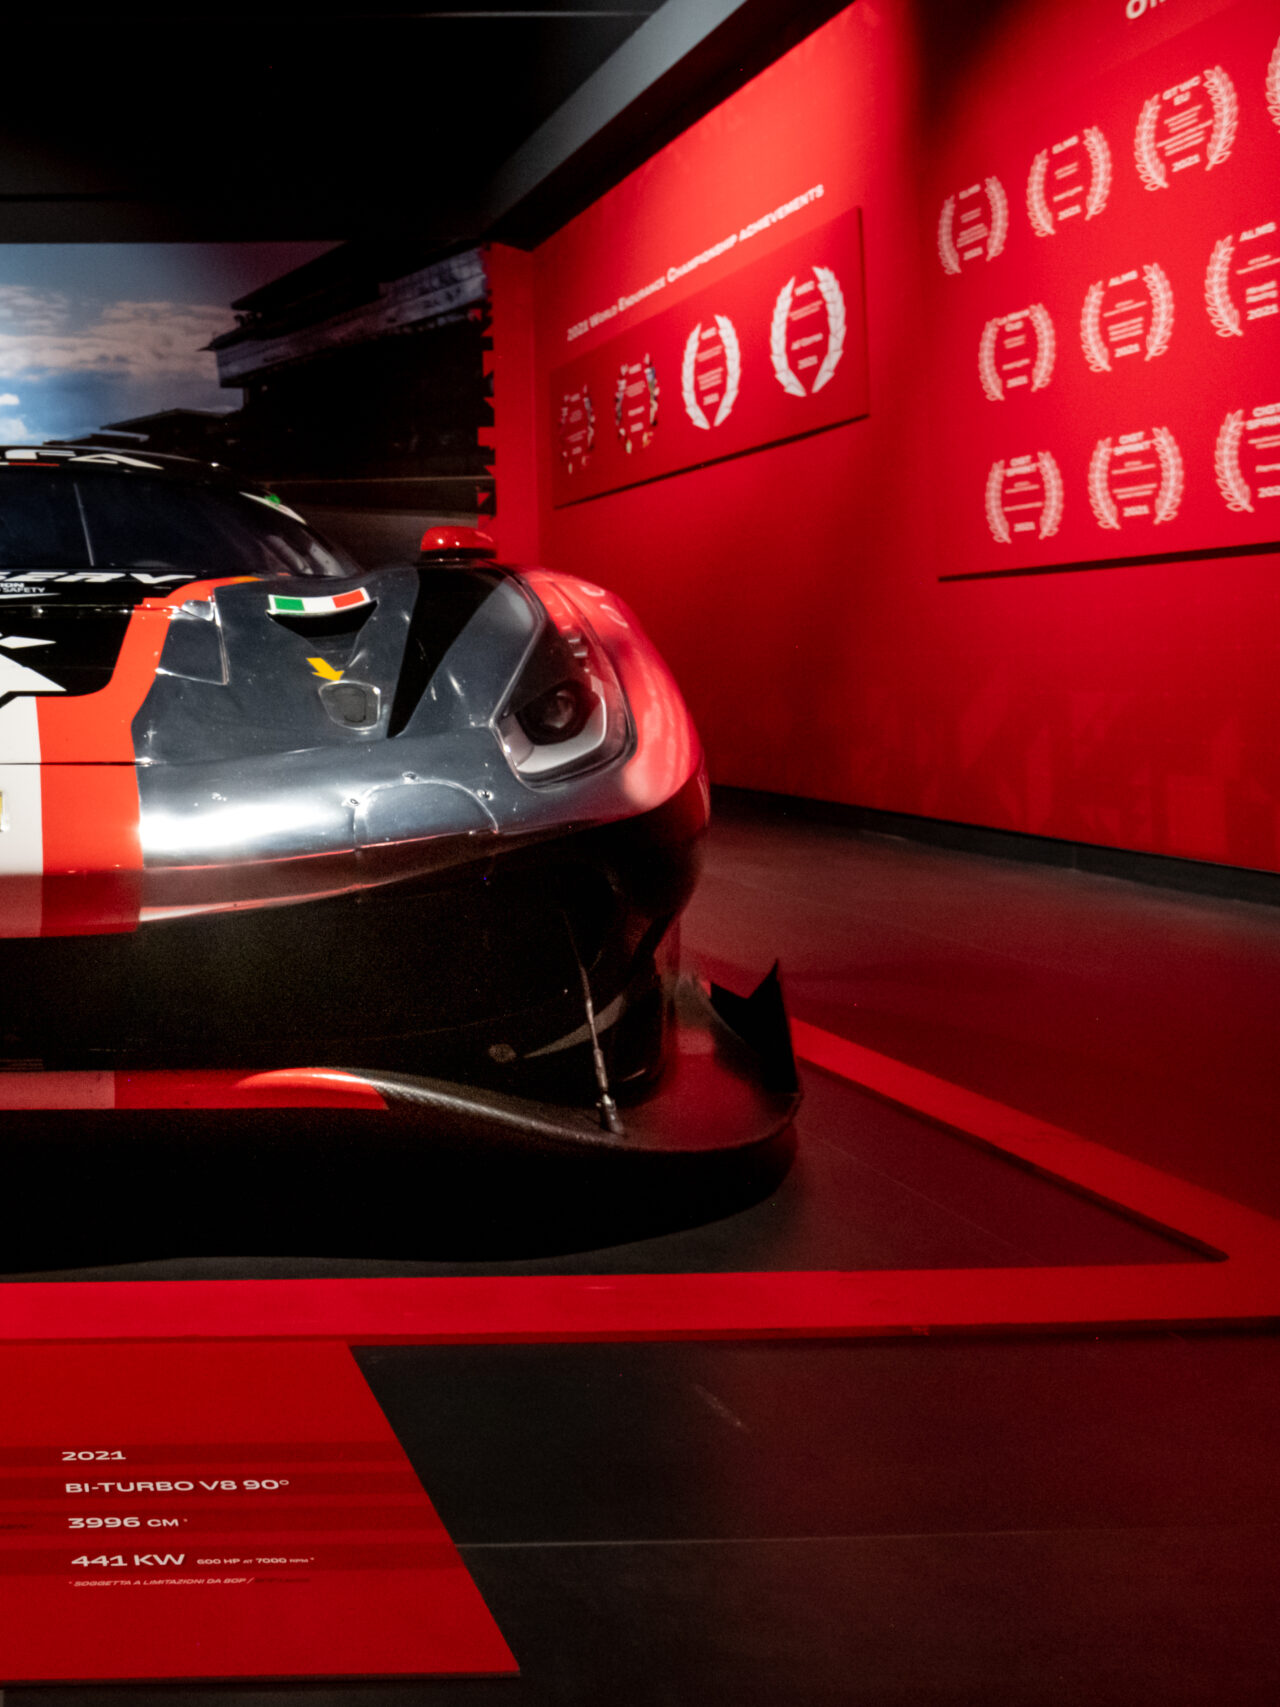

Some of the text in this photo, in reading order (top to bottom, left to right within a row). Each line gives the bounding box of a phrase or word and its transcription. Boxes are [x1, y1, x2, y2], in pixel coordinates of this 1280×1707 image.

[61, 1450, 127, 1461] 2021
[65, 1481, 195, 1493] BI-TURBO
[199, 1480, 238, 1491] V8
[68, 1517, 141, 1529] 3996
[71, 1554, 128, 1567] 441
[134, 1553, 185, 1566] KW
